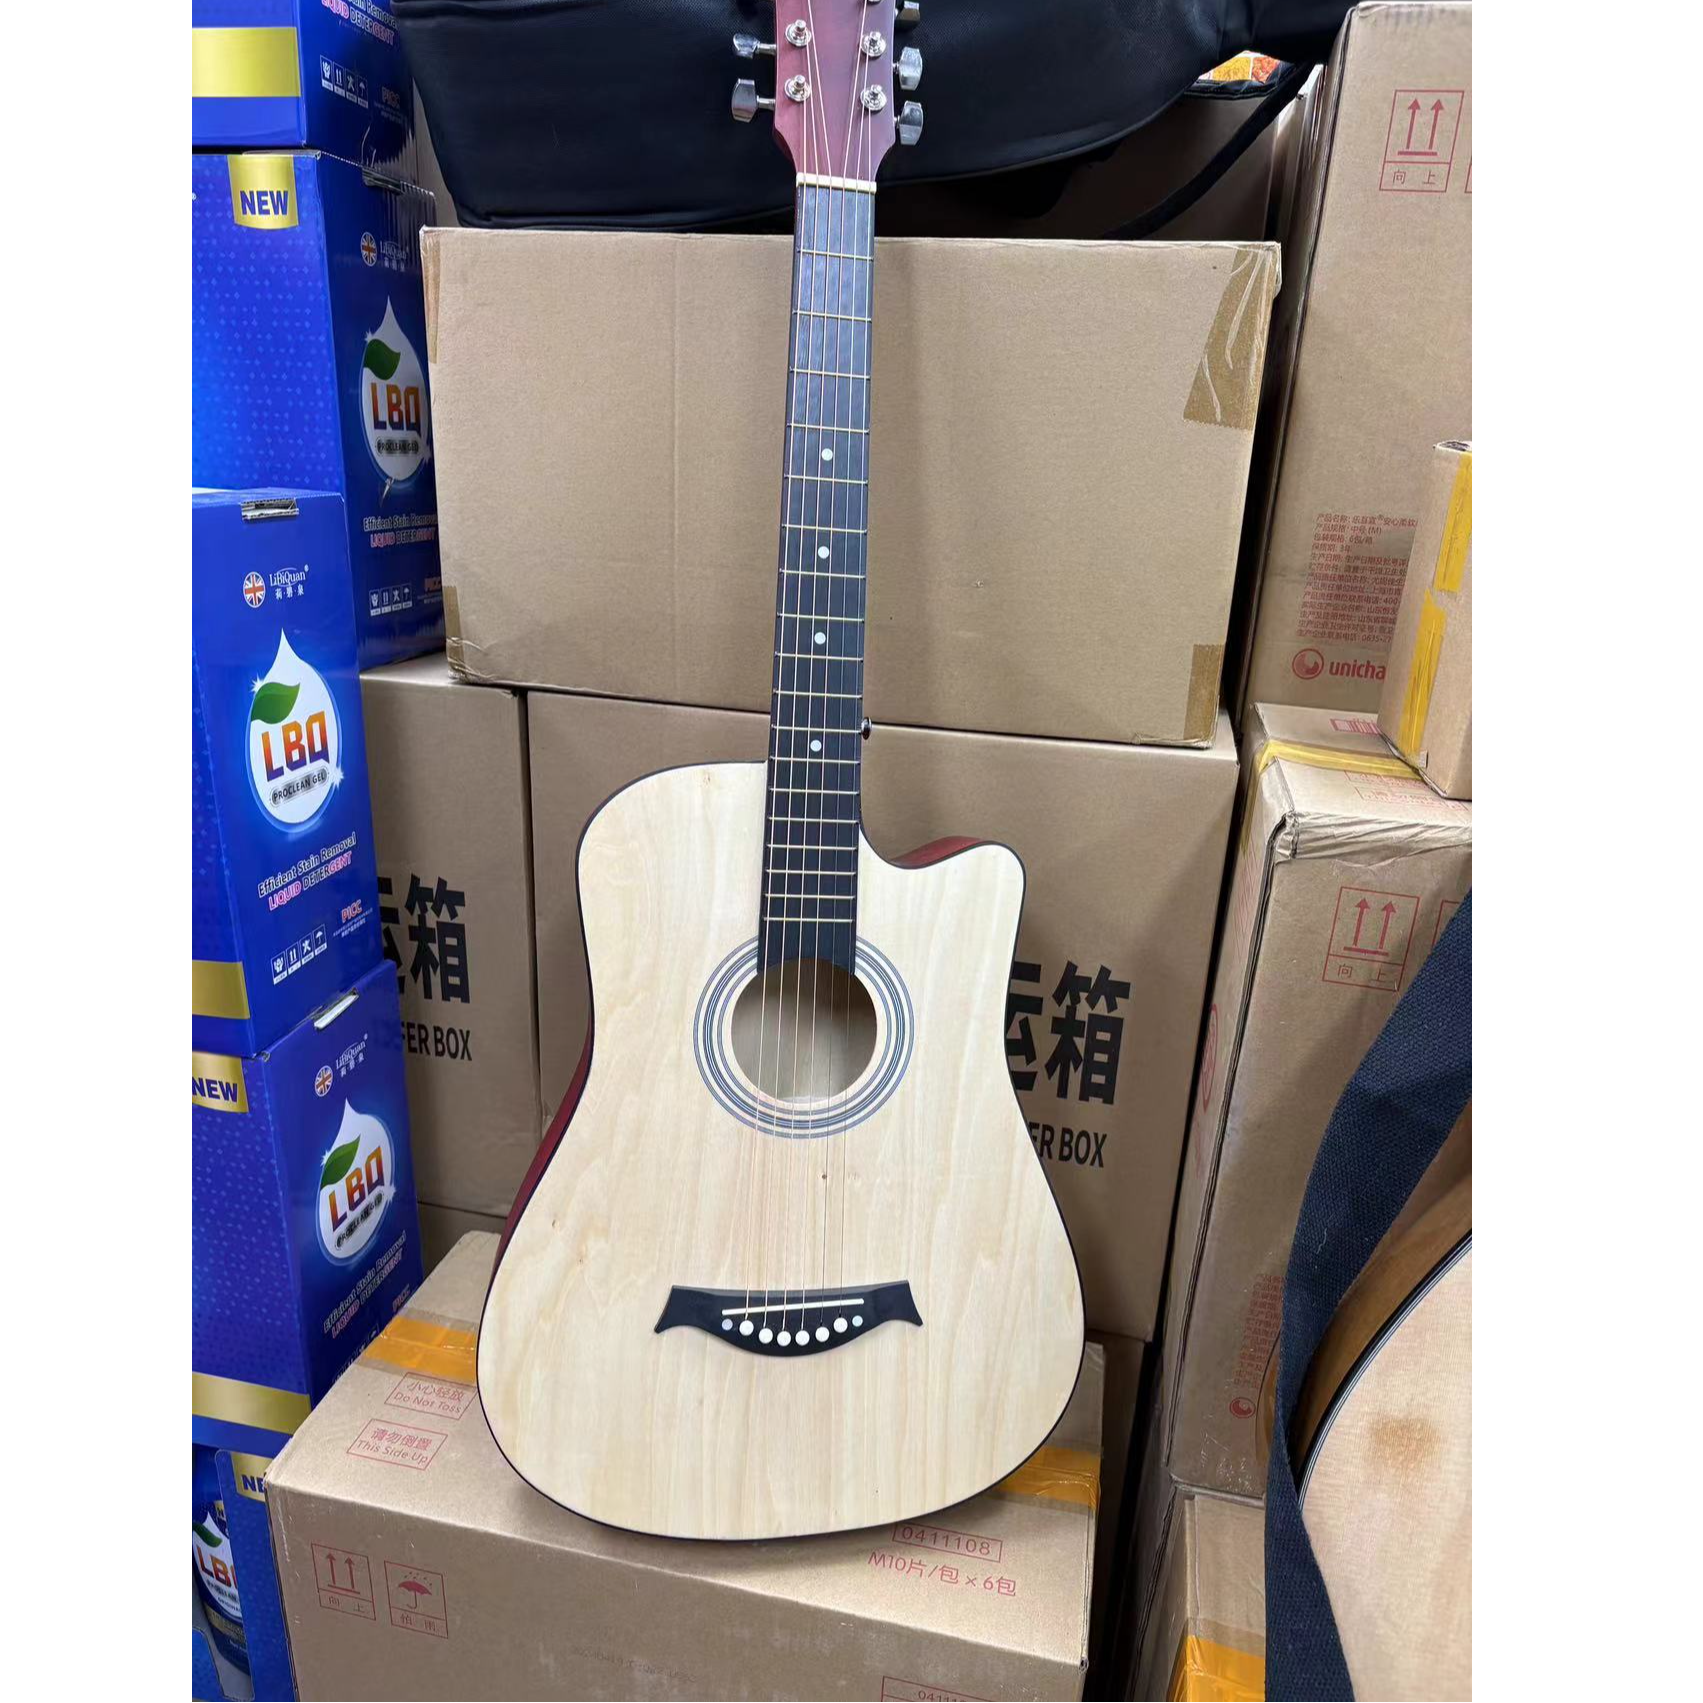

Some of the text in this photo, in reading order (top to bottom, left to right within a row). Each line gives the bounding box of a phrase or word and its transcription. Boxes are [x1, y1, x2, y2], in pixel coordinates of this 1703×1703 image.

[240, 190, 288, 215] NEW
[1329, 660, 1386, 680] unicha
[261, 711, 330, 782] LBQ
[273, 772, 325, 802] PROCLEAN GEL
[258, 831, 357, 898] Efficient Stain Removal
[268, 850, 352, 911] LIQUID DETERGENT
[341, 899, 362, 923] PICC
[1337, 963, 1387, 983] 向上
[402, 1022, 472, 1061] ER BOX
[192, 1077, 238, 1102] NEW
[1058, 1127, 1108, 1168] BOX
[328, 1146, 385, 1232] LBQ
[393, 1392, 462, 1414] Do Not Toss
[357, 1440, 429, 1465] This Side Up
[901, 1526, 991, 1556] 0411108
